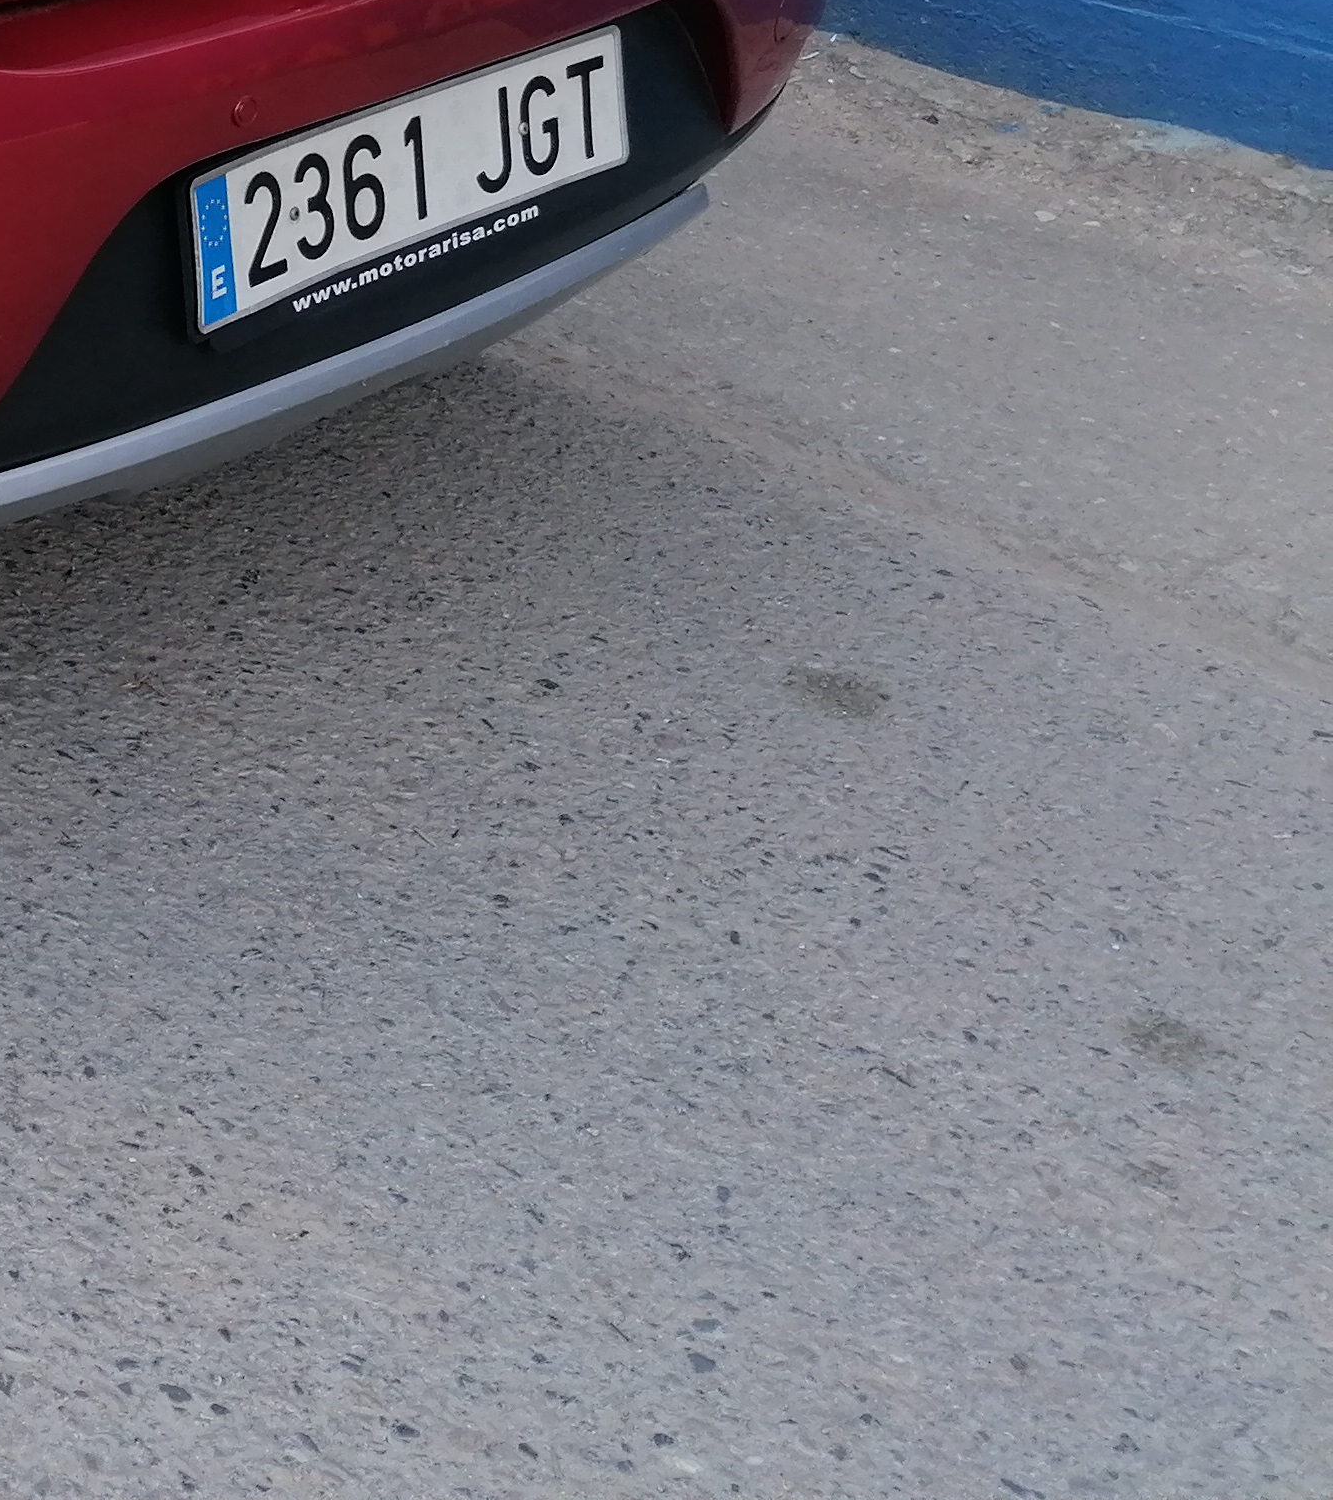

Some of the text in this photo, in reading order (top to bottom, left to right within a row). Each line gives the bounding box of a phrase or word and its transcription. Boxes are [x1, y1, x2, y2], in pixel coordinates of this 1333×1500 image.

[243, 54, 605, 289] 2361 JGT
[211, 264, 227, 300] E
[291, 203, 540, 314] www.motorarisa.com
